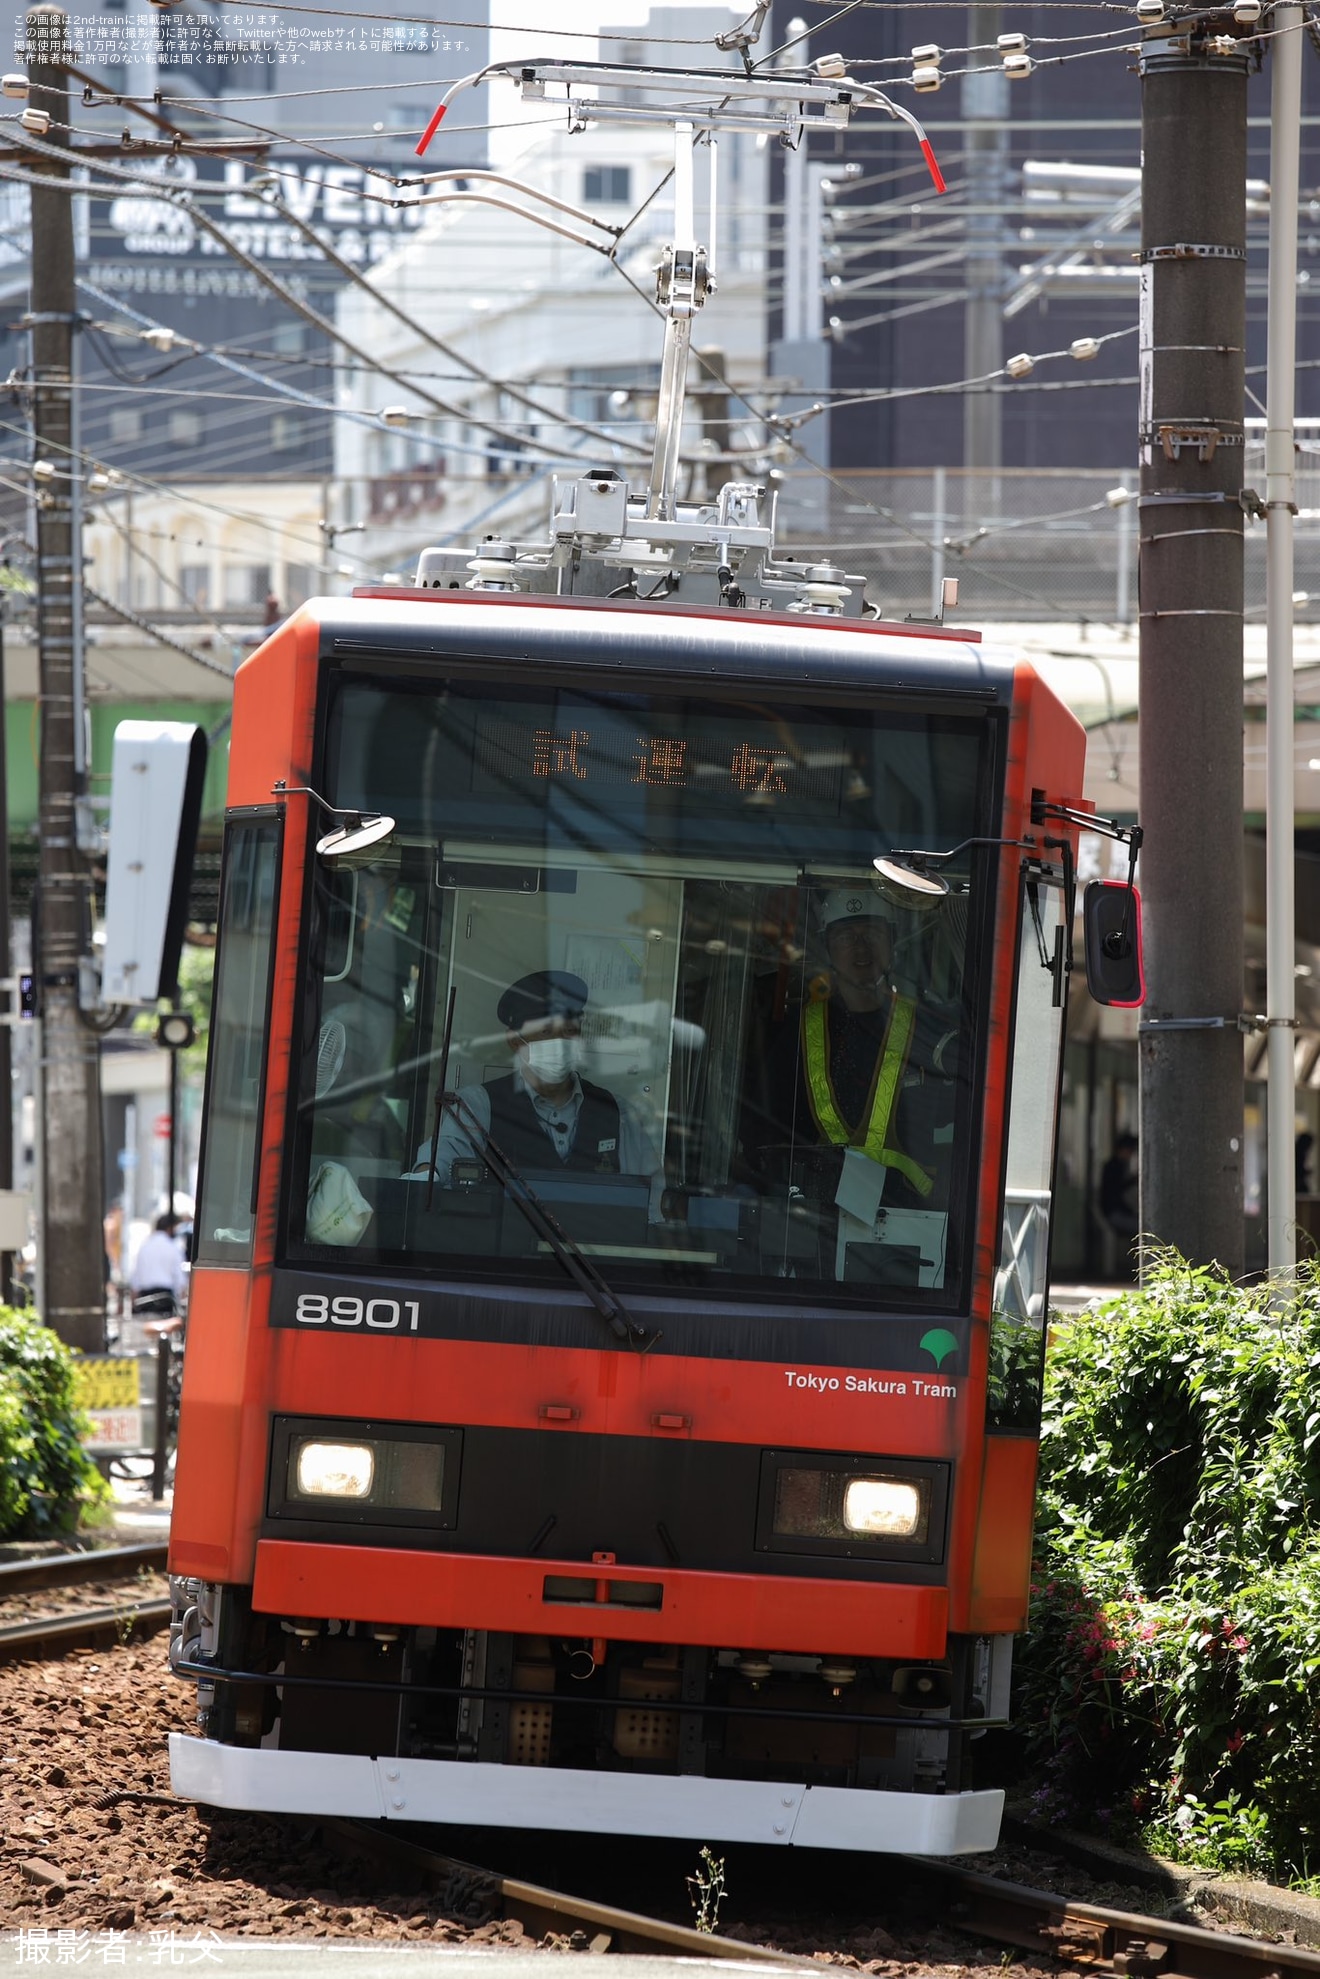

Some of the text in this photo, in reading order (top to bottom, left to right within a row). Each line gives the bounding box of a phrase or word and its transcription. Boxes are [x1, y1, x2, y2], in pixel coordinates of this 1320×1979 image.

[532, 729, 788, 793] 試運転
[295, 1294, 420, 1330] 8901
[784, 1371, 957, 1398] Tokyo Sakura Tram
